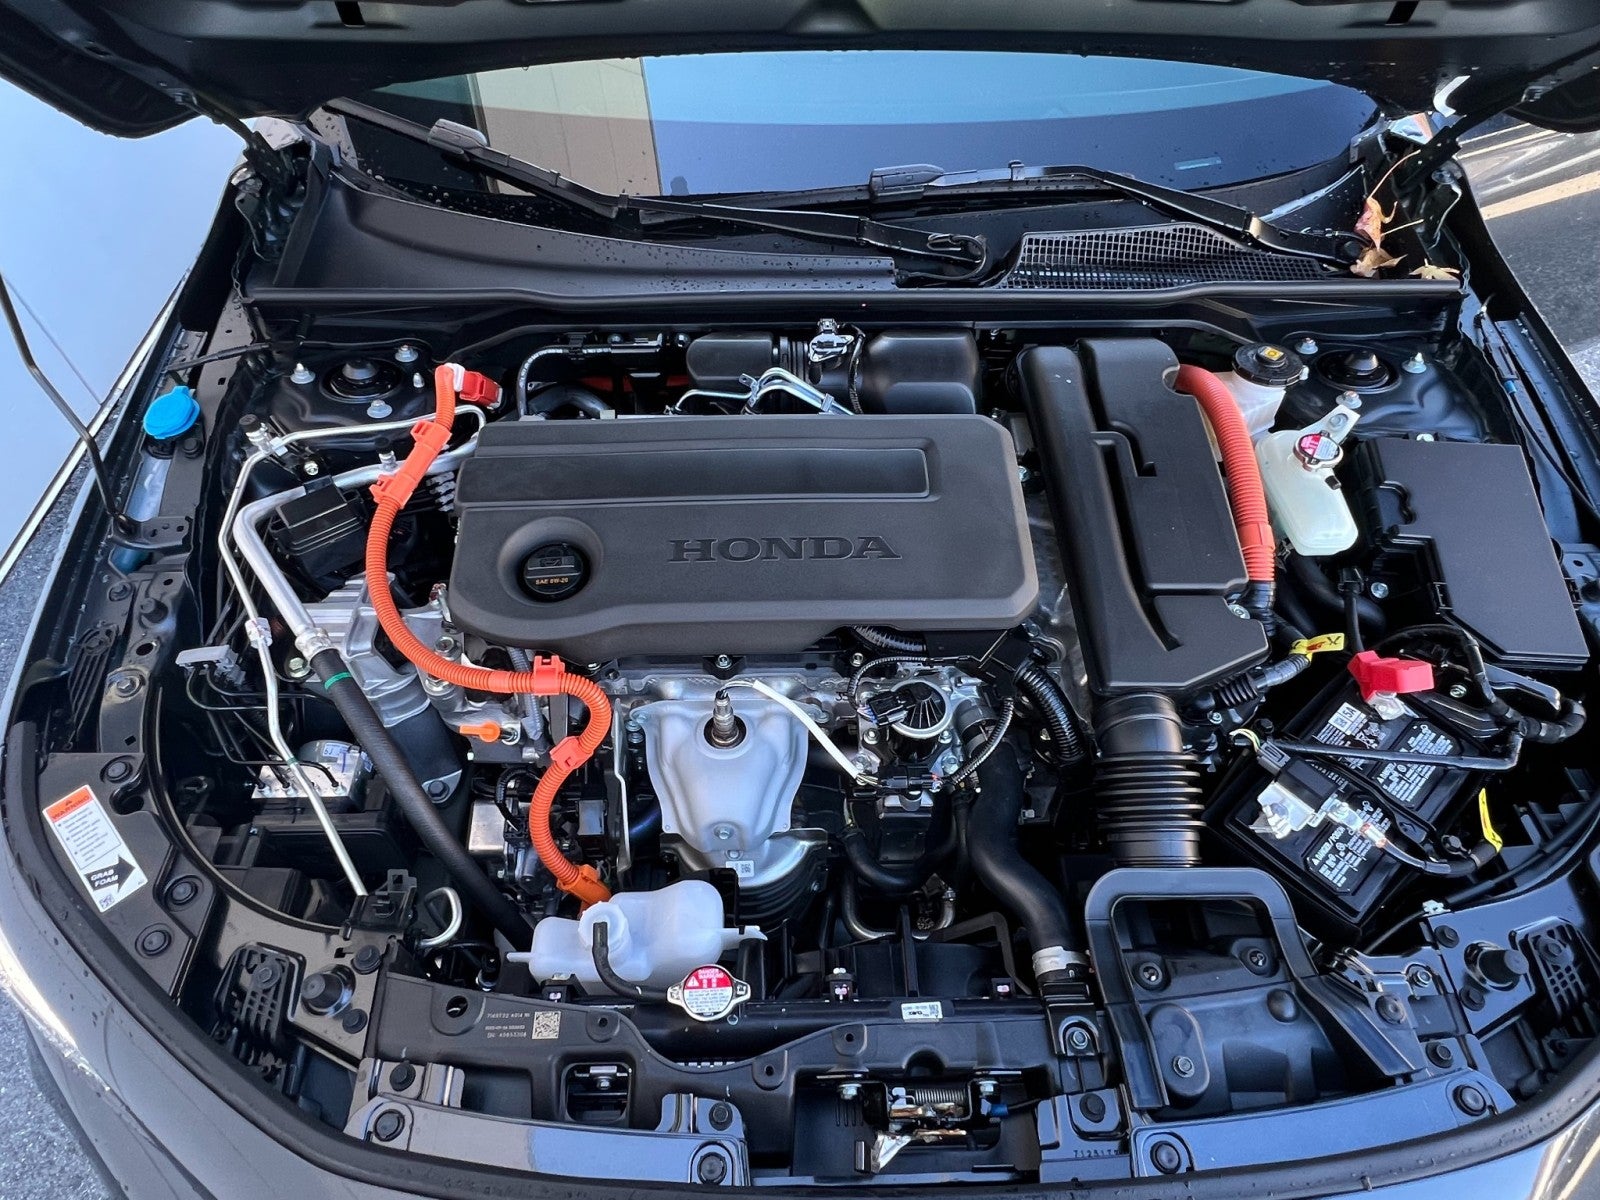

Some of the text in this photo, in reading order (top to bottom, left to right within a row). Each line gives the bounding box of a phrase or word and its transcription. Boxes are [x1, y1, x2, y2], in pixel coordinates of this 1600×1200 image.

[667, 536, 903, 563] HONDA
[91, 869, 115, 880] GRAB
[95, 876, 119, 887] FOAM
